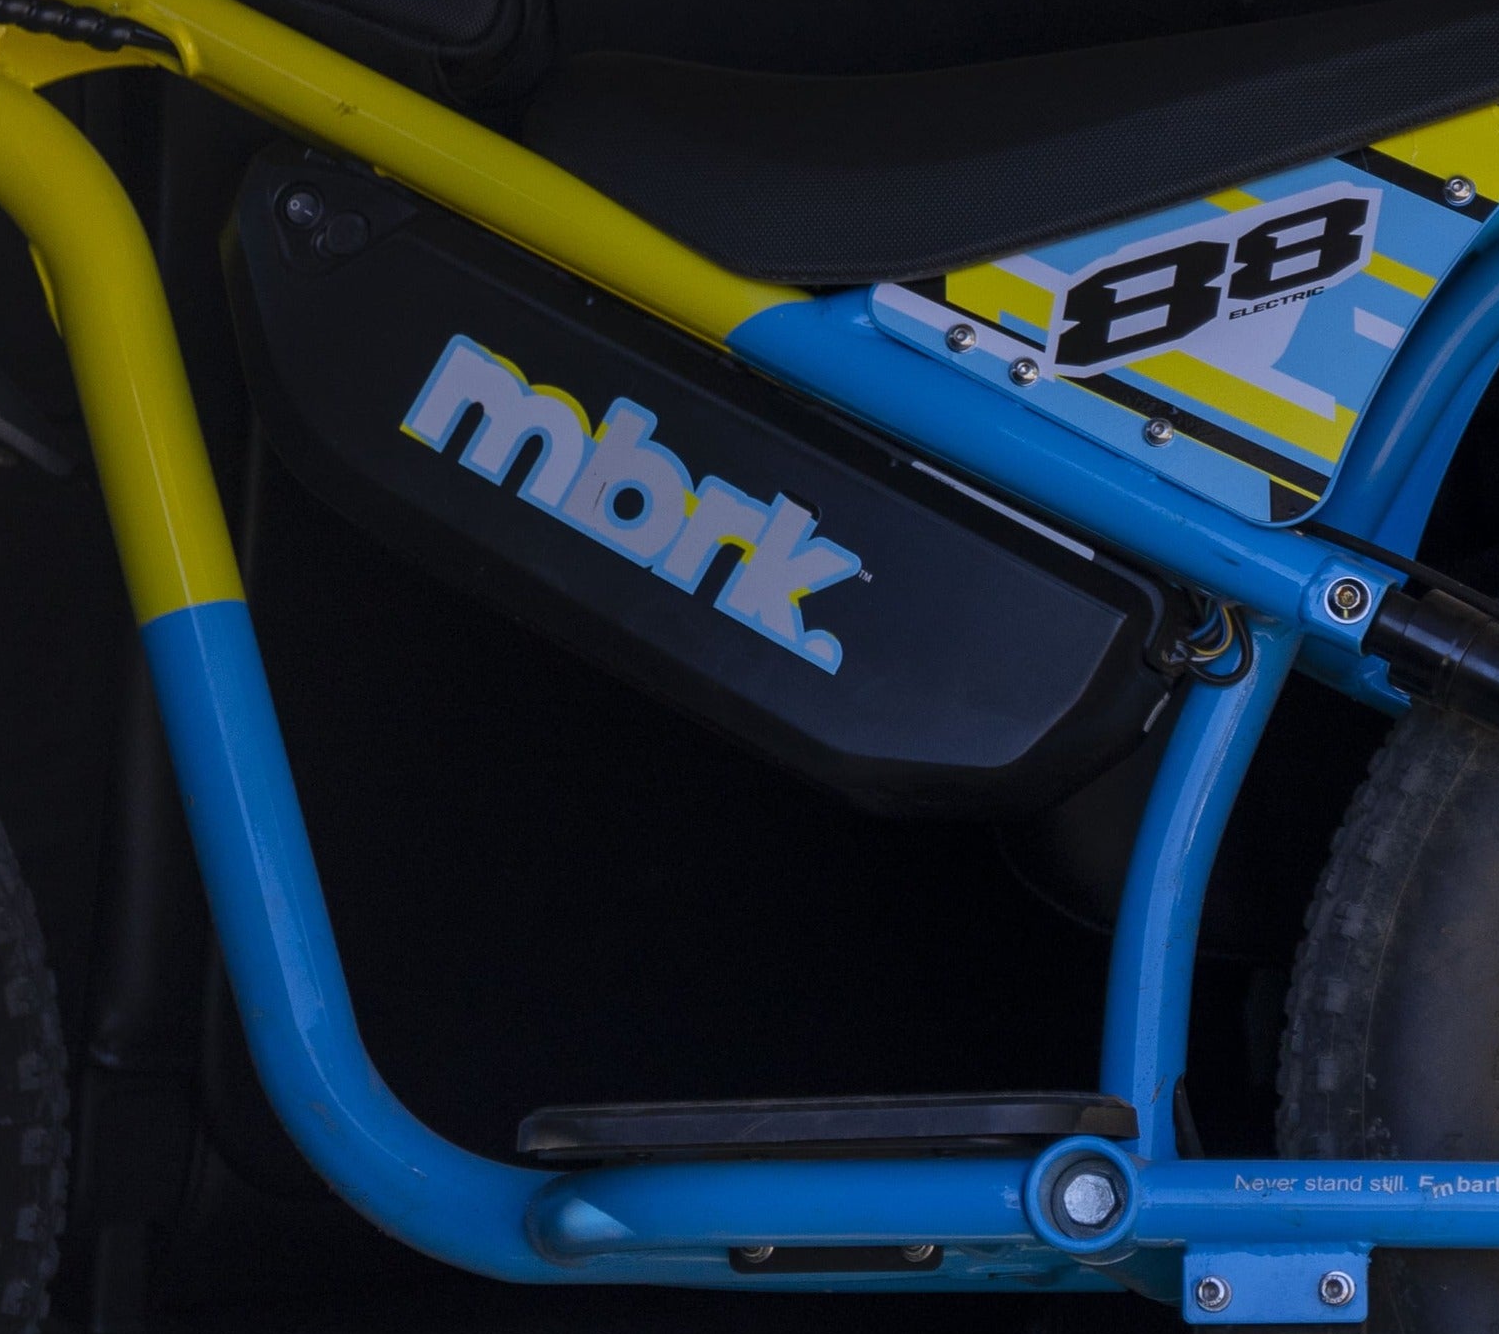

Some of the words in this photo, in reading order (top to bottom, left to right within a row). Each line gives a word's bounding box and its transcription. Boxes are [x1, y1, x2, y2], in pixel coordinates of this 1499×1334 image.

[1055, 197, 1369, 366] 88
[1229, 286, 1325, 320] ELECTRIC
[1235, 1174, 1297, 1192] Never
[1305, 1174, 1362, 1192] stand
[1370, 1174, 1409, 1194] still.
